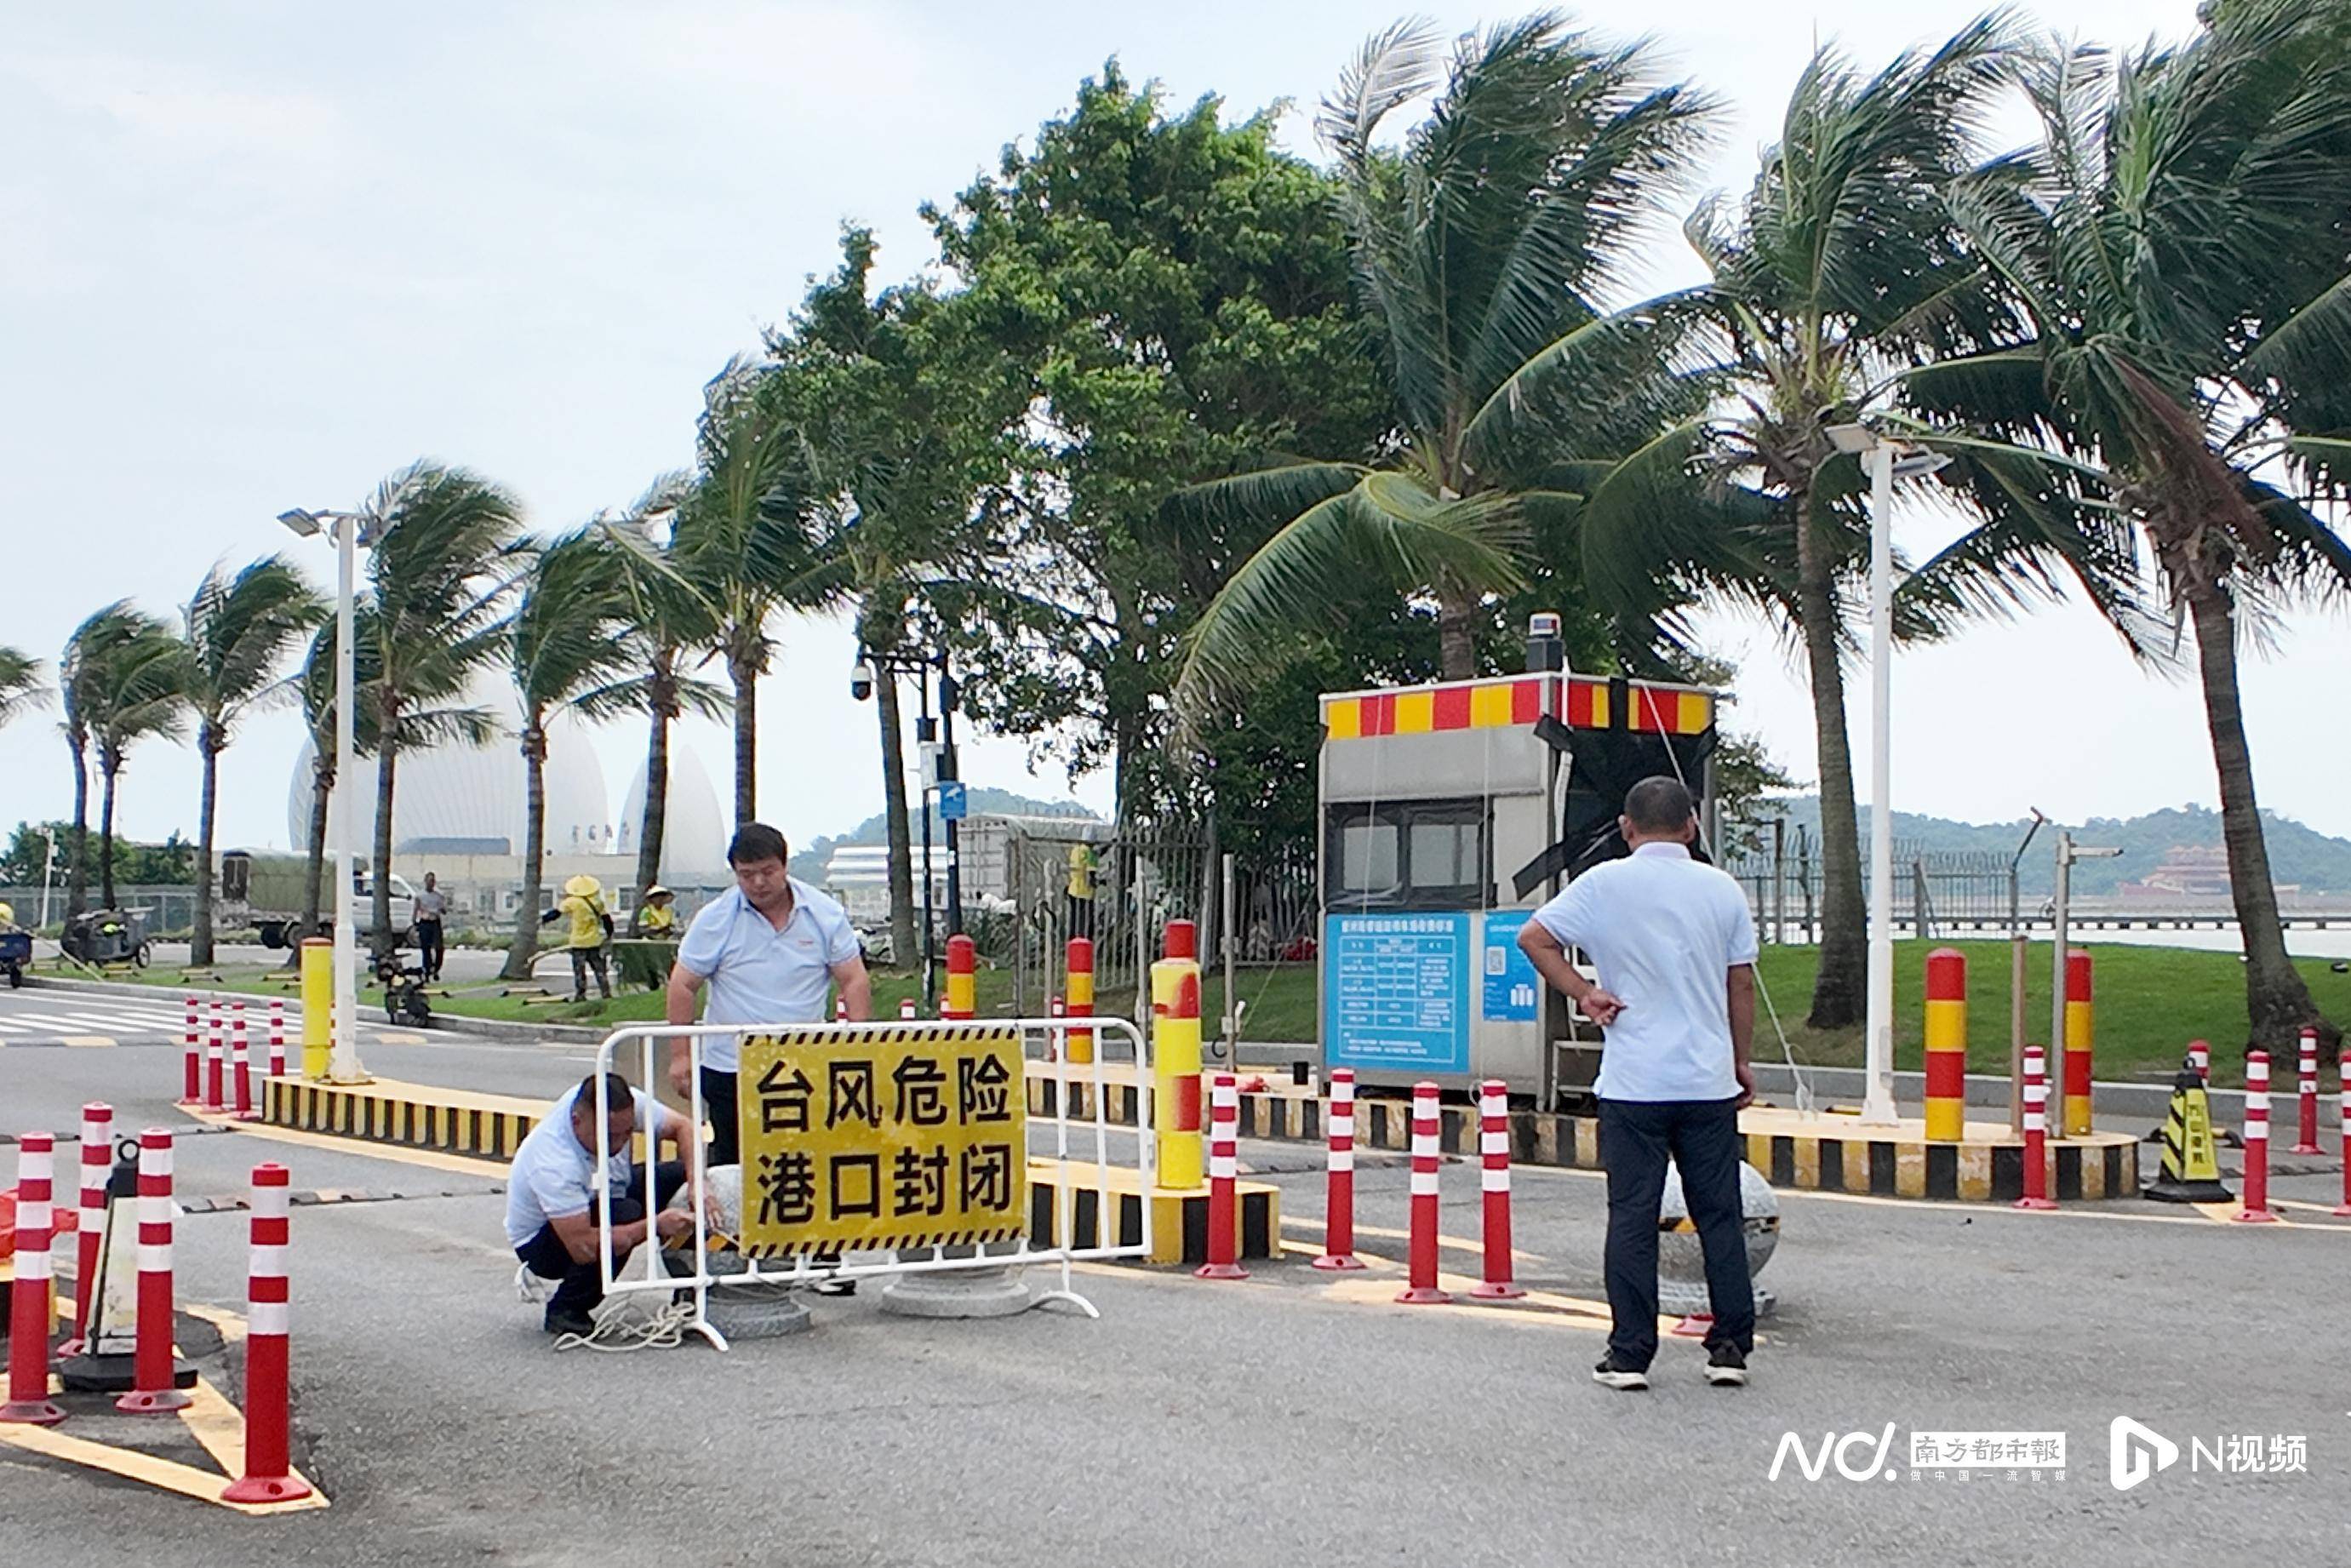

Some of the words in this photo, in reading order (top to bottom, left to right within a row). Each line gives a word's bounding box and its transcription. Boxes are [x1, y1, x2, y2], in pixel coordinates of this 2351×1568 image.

[757, 1053, 1011, 1134] 台风危险
[757, 1143, 1011, 1226] 港口封闭
